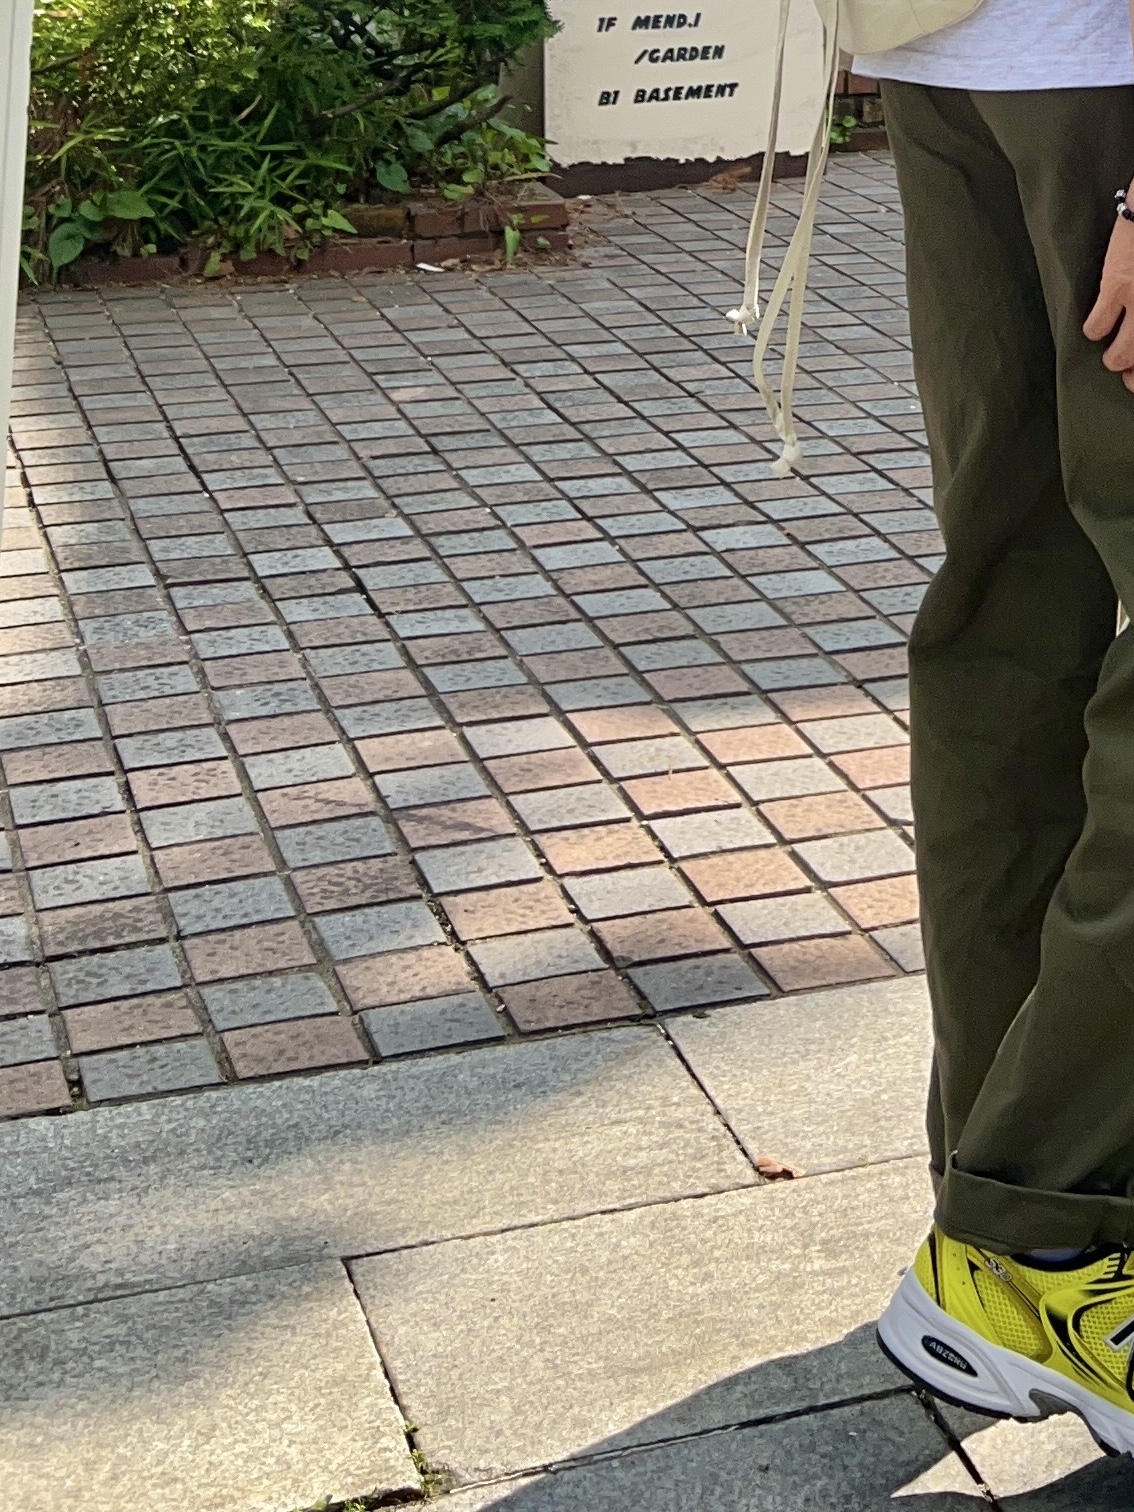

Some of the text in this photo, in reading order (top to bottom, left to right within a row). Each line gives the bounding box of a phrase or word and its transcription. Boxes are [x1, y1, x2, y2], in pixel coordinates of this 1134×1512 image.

[597, 17, 618, 33] 1F
[634, 44, 726, 65] /GARDEN
[598, 82, 740, 106] B1 BASEMENT
